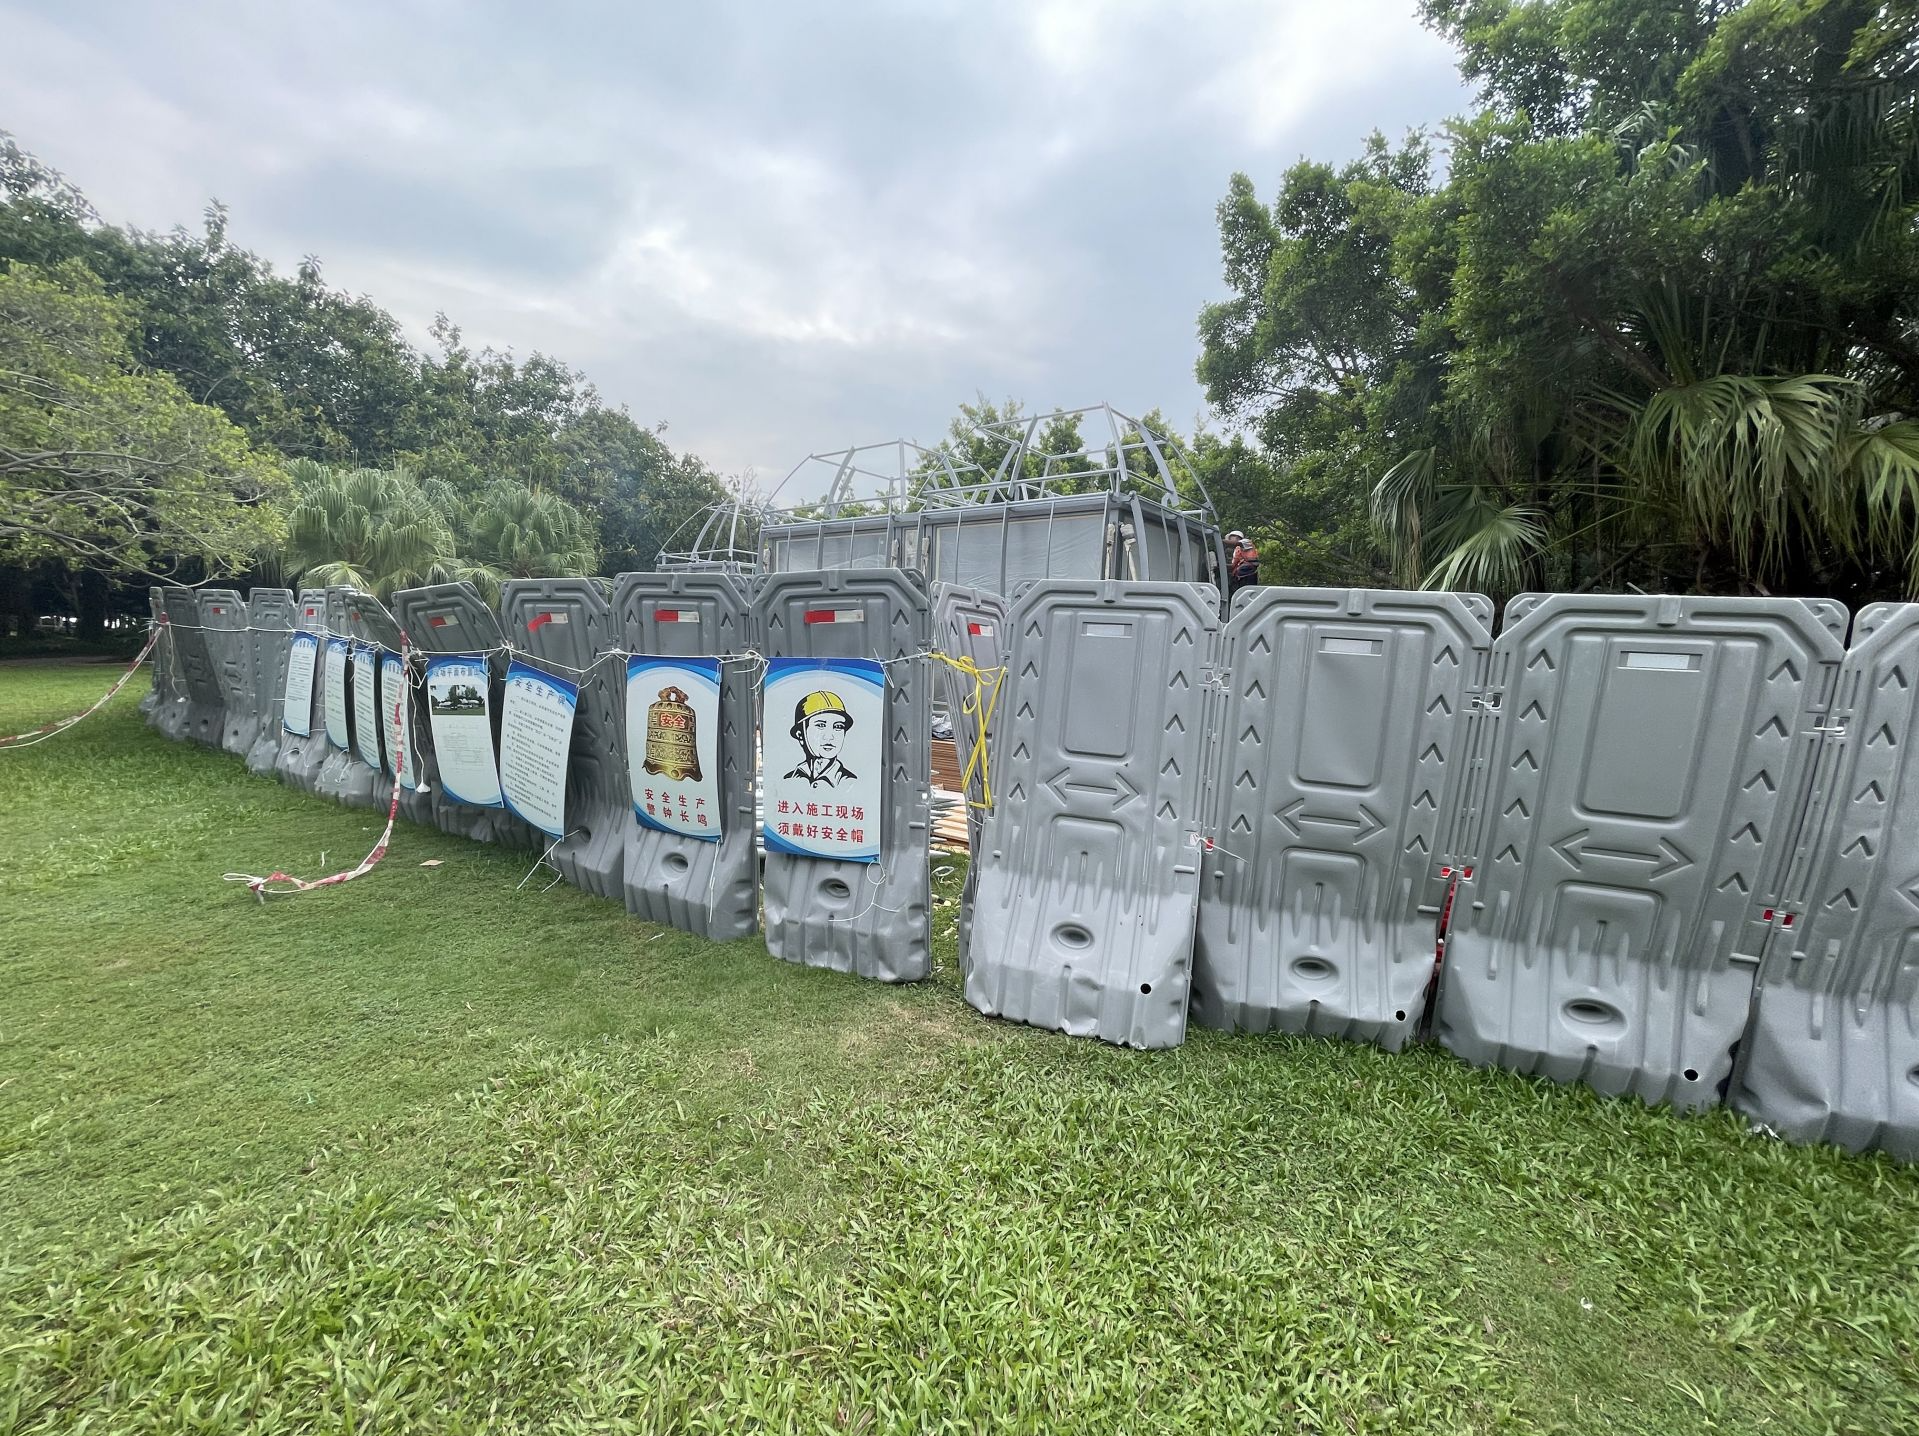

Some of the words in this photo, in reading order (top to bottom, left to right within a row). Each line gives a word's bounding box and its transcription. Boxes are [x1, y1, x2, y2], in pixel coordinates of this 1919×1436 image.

[514, 676, 567, 705] 安全生产牌
[660, 712, 686, 729] 安全
[644, 788, 705, 809] 安全生产
[646, 803, 708, 826] 警钟长鸣
[777, 800, 865, 821] 进入施工现场
[777, 822, 865, 843] 须戴好安全帽
